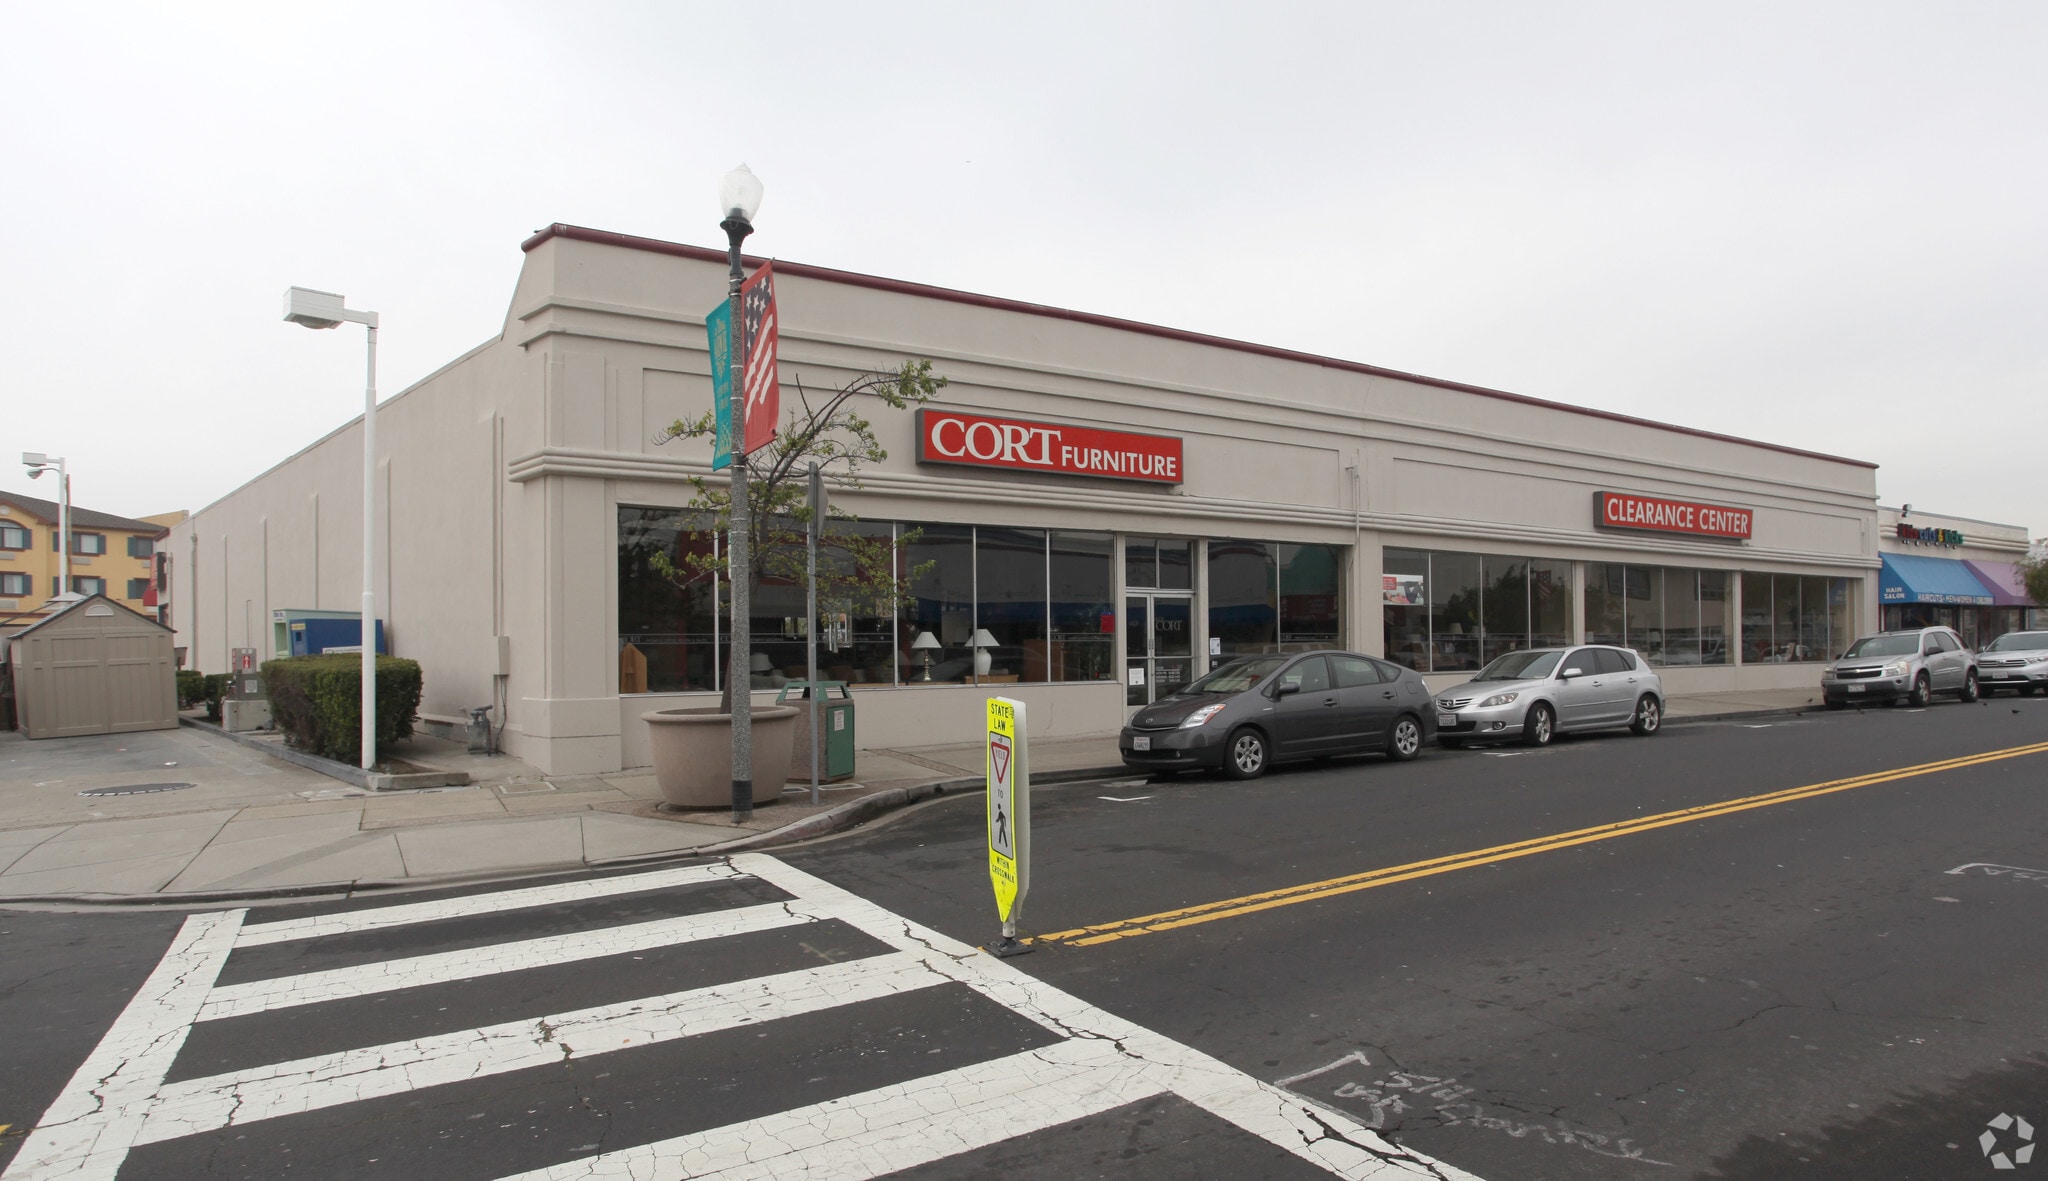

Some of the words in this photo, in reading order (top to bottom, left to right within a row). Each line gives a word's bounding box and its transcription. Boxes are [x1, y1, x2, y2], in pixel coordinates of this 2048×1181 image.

[931, 418, 1061, 465] CORT
[1062, 446, 1176, 476] FURNITURE
[1608, 498, 1694, 528] CLEARANCE
[1700, 508, 1748, 534] CENTER
[1156, 620, 1182, 631] CORT
[991, 703, 1009, 718] STATE
[994, 718, 1006, 731] LAW
[997, 789, 1003, 799] TO
[997, 856, 1010, 870] WITHIN
[992, 864, 1015, 883] CROSSWALK
